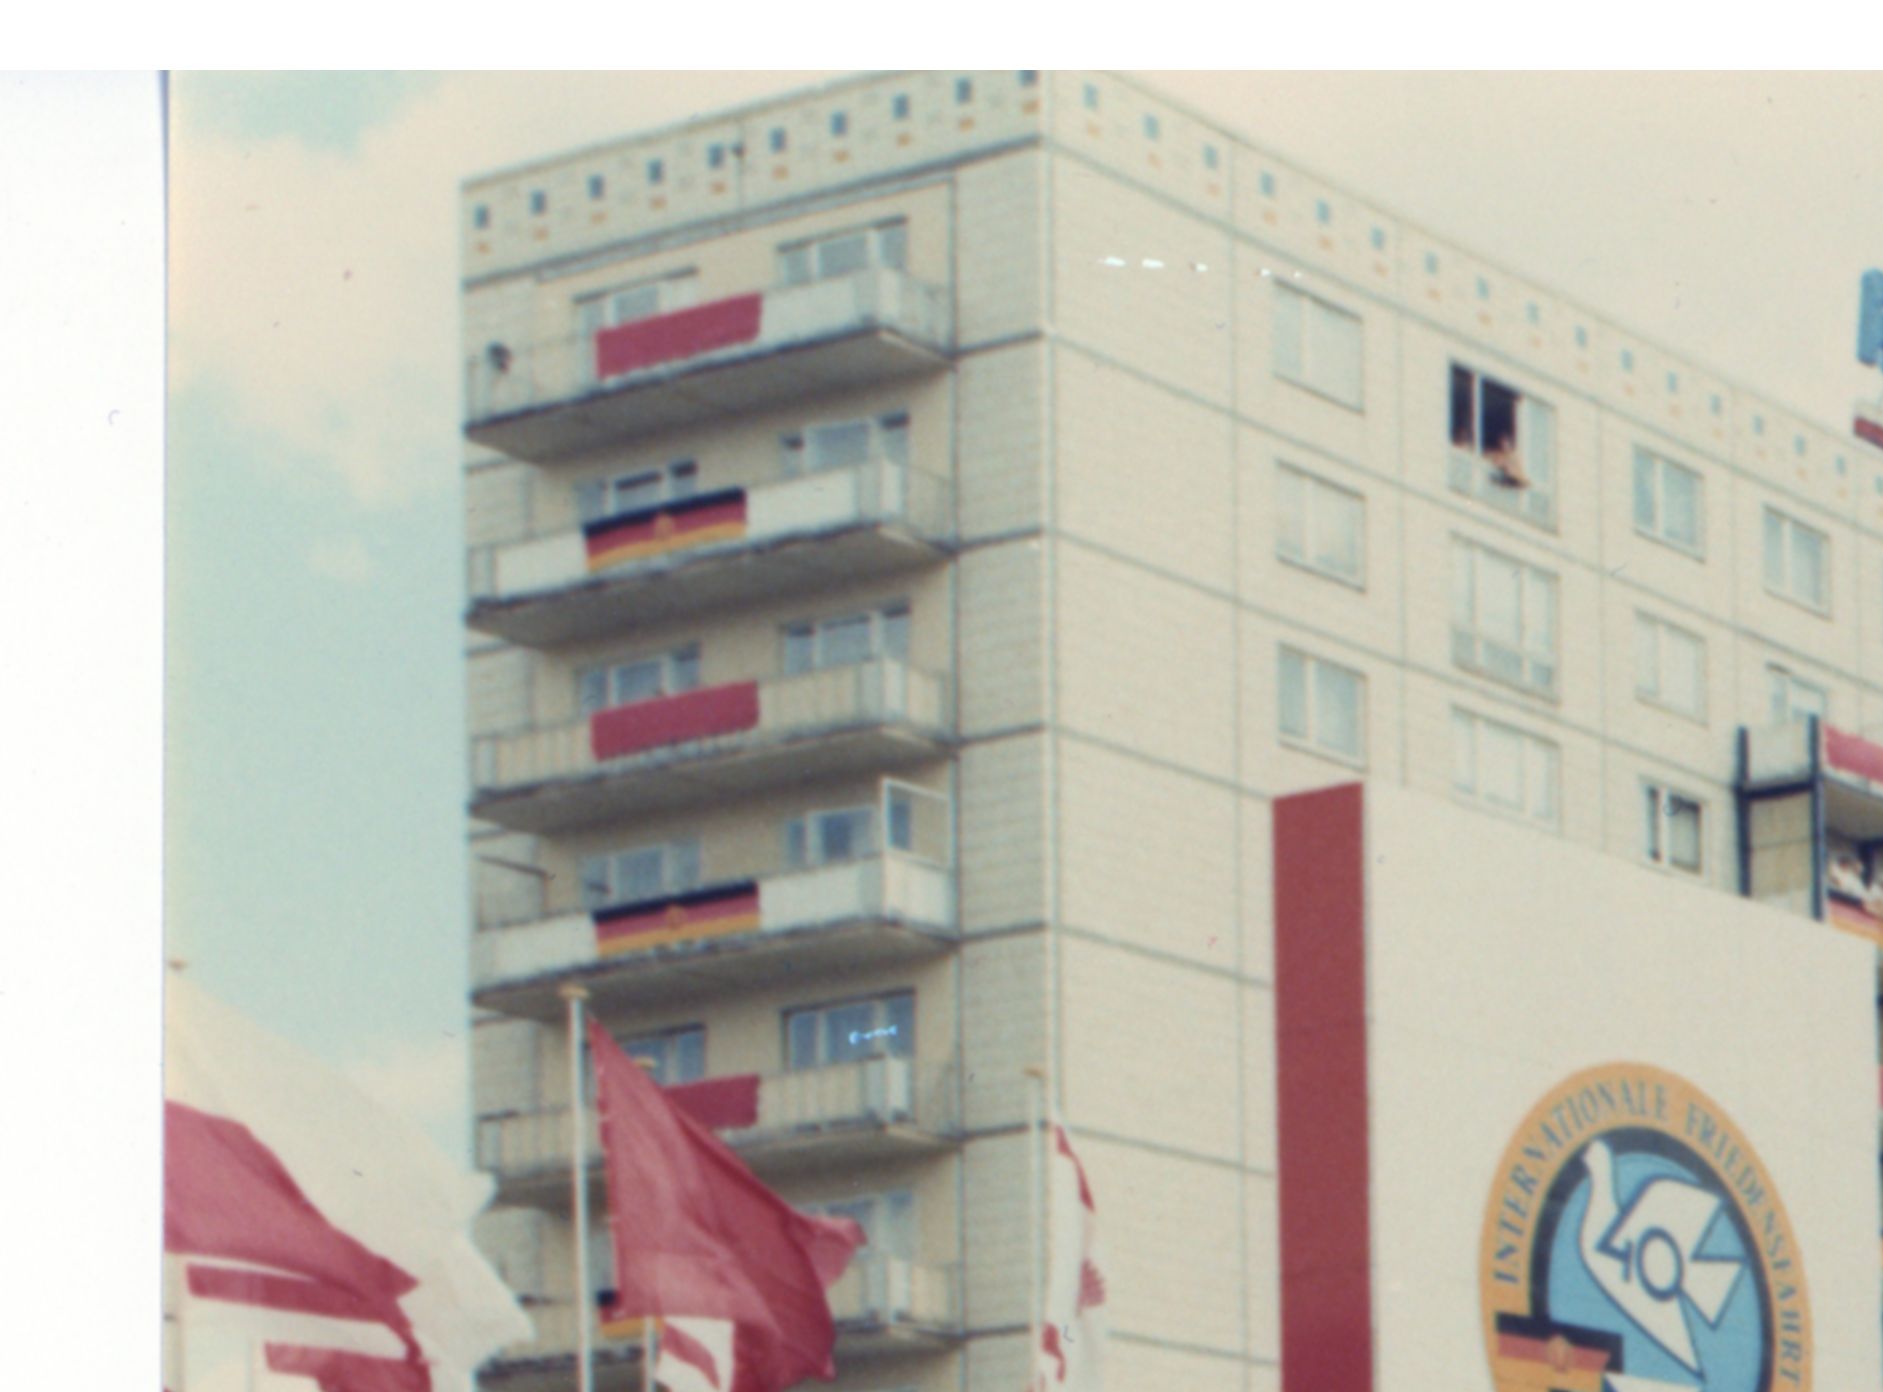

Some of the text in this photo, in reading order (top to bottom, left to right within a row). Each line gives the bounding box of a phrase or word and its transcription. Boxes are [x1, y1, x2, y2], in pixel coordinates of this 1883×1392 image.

[1493, 1078, 1803, 1390] INTERNATIONALE FRIEDENSFAHRT
[1594, 1222, 1683, 1302] 40
